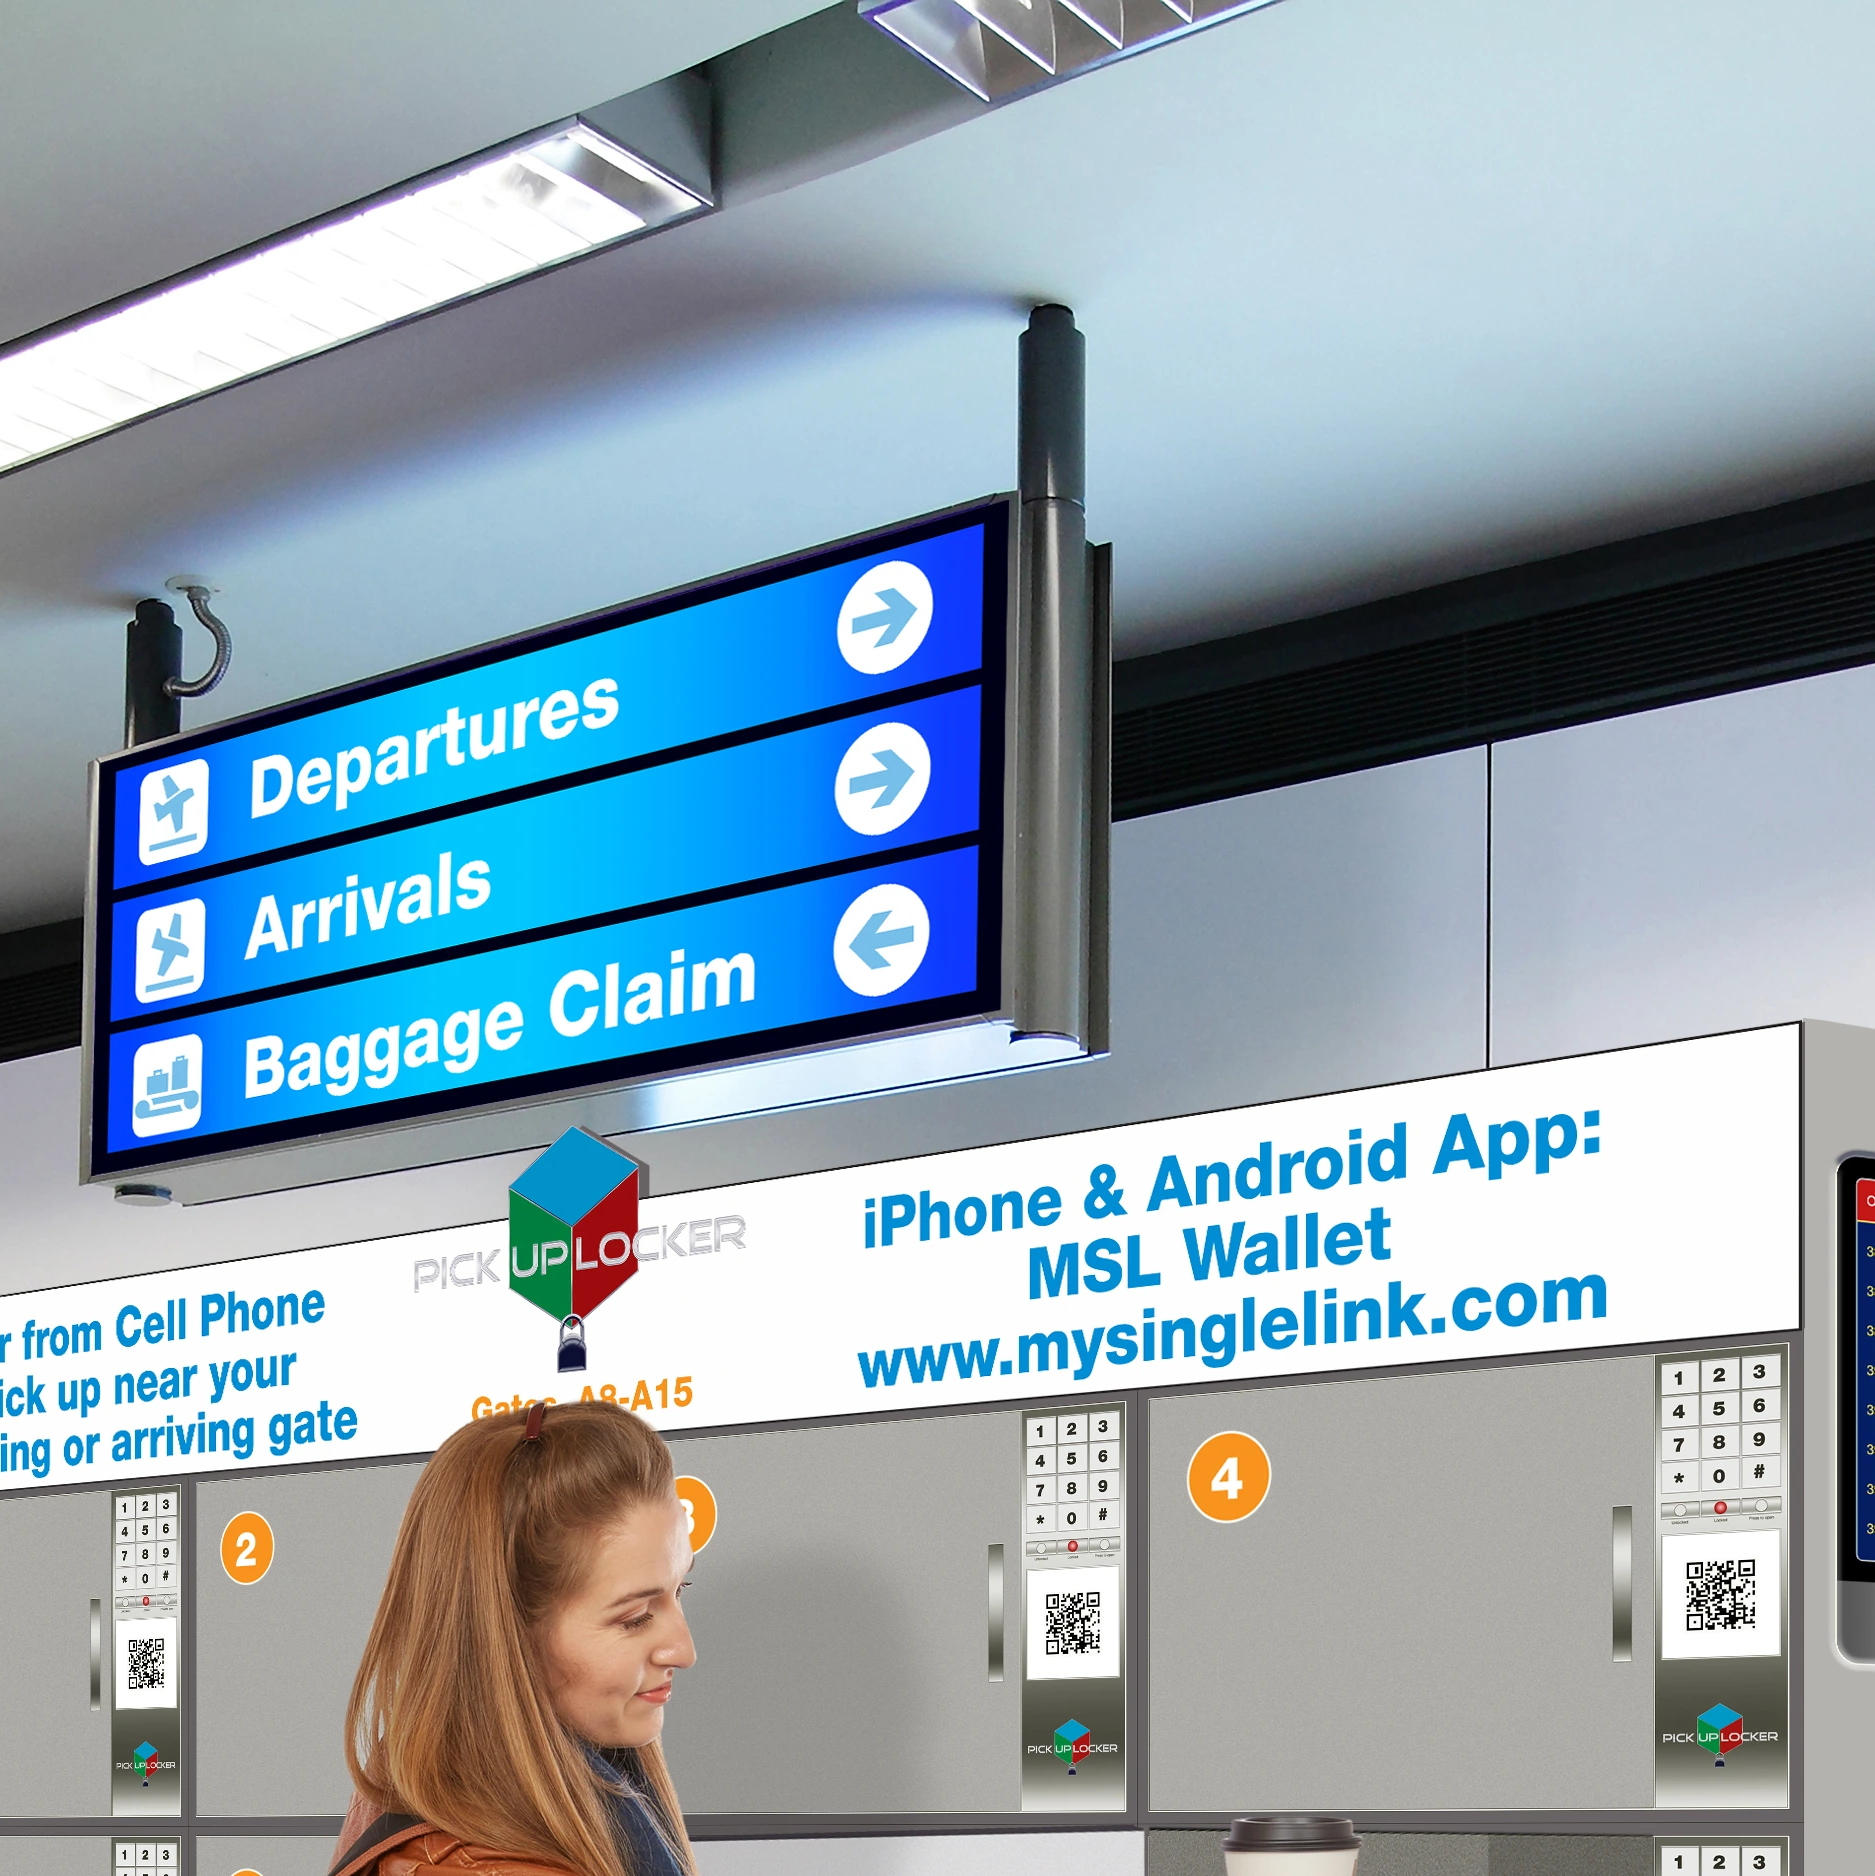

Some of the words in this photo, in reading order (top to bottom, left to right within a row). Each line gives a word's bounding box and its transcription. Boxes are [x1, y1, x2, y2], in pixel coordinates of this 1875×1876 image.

[252, 679, 618, 818] Departures
[245, 852, 490, 959] Arrivals
[246, 1002, 523, 1098] Baggage
[550, 949, 754, 1036] Claim
[865, 1186, 1062, 1248] iPhone
[1084, 1164, 1127, 1219] &
[1146, 1122, 1406, 1212] Android
[1432, 1110, 1600, 1180] App:
[414, 1249, 502, 1294] PICK
[512, 1239, 570, 1279] UP
[575, 1214, 748, 1271] LOCKER
[1030, 1235, 1161, 1300] MSL
[1183, 1207, 1391, 1281] Wallet
[22, 1320, 101, 1360] from
[116, 1298, 186, 1347] Cell
[202, 1290, 325, 1336] Phone
[858, 1270, 1606, 1388] www.mysinglelink.com
[58, 1377, 100, 1418] up
[115, 1365, 198, 1404] near
[209, 1352, 297, 1404] your
[1674, 1371, 1683, 1386] 1
[1712, 1367, 1726, 1383] 2
[1752, 1364, 1766, 1379] 3
[64, 1433, 100, 1466] or
[112, 1412, 254, 1462] arriving
[269, 1400, 357, 1456] gate
[1672, 1404, 1686, 1419] 4
[1712, 1401, 1726, 1416] 5
[1753, 1398, 1766, 1413] 6
[1673, 1437, 1685, 1453] 7
[1712, 1434, 1726, 1450] 8
[1753, 1431, 1766, 1447] 9
[1713, 1468, 1726, 1484] 0
[1753, 1463, 1765, 1479] #
[1212, 1458, 1242, 1499] 4
[236, 1532, 255, 1566] 2
[1662, 1733, 1695, 1744] PICK
[1697, 1732, 1719, 1743] UP
[1720, 1731, 1779, 1742] LOCKER
